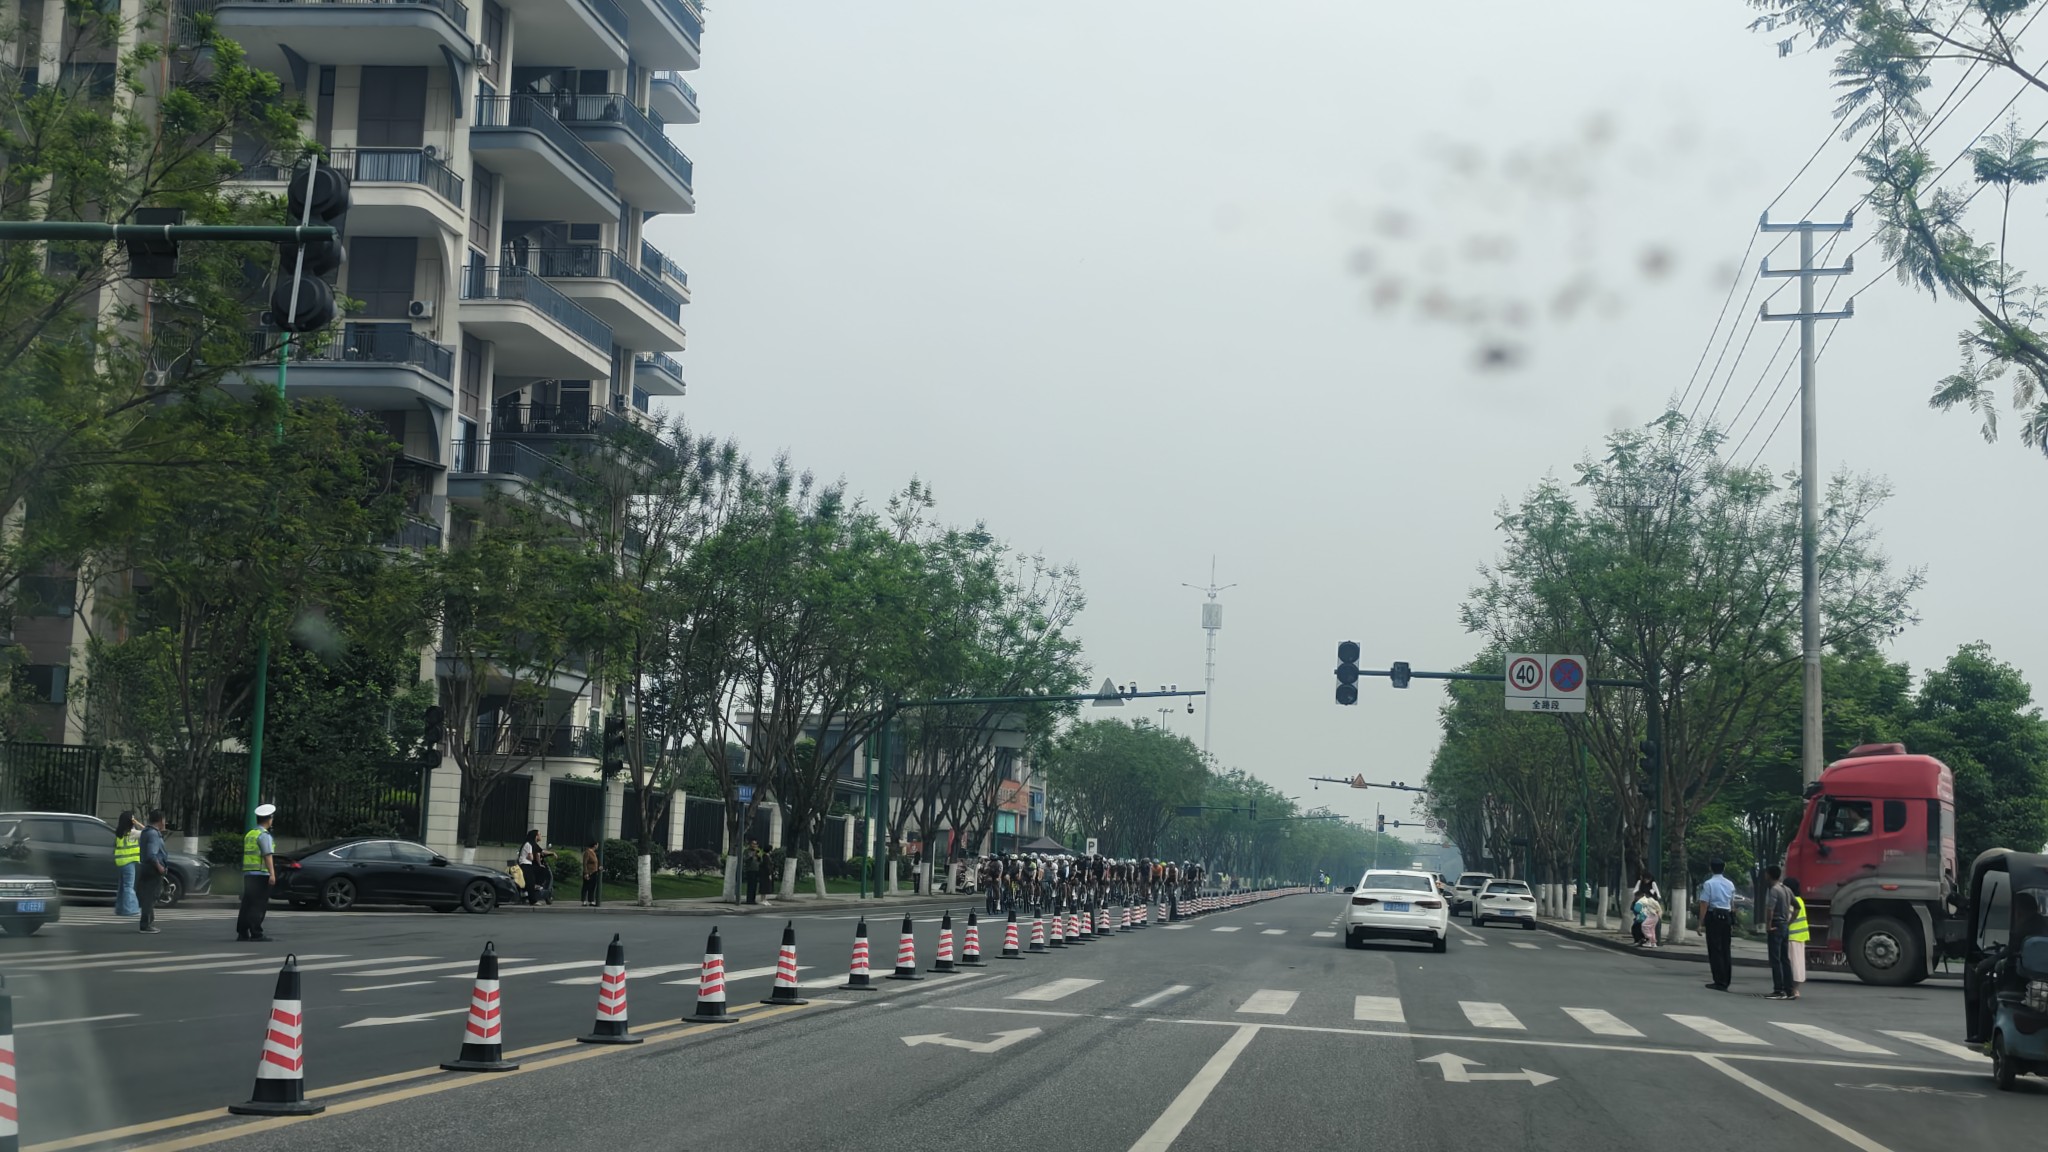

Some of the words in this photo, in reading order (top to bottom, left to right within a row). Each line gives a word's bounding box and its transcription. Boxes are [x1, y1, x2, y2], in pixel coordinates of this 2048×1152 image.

[1516, 664, 1535, 684] 40
[1532, 699, 1560, 710] 全路段
[1088, 841, 1095, 851] P
